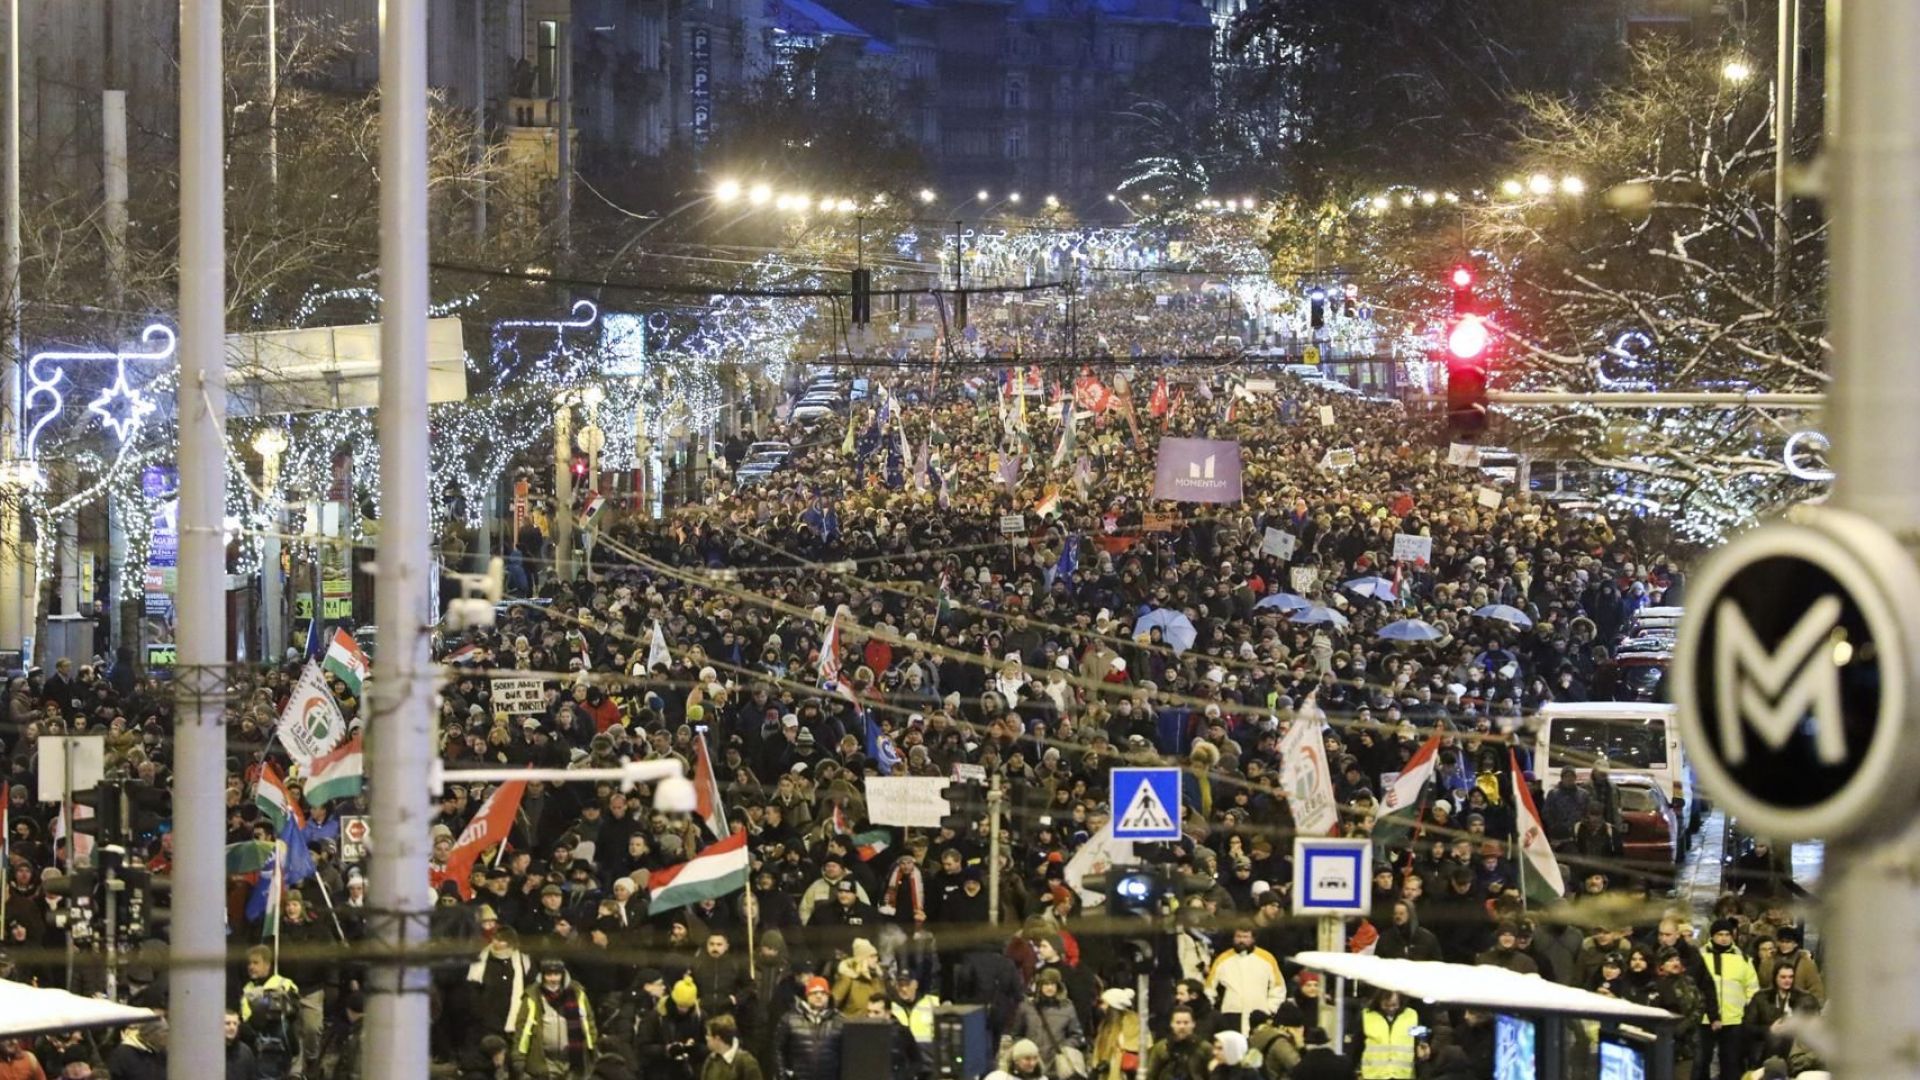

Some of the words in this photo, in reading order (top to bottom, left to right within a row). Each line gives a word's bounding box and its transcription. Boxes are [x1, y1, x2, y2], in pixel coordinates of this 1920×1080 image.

[695, 36, 707, 49] P
[695, 74, 707, 87] P
[696, 112, 708, 126] P
[1175, 478, 1227, 488] MOMENTUM
[1714, 594, 1847, 765] M
